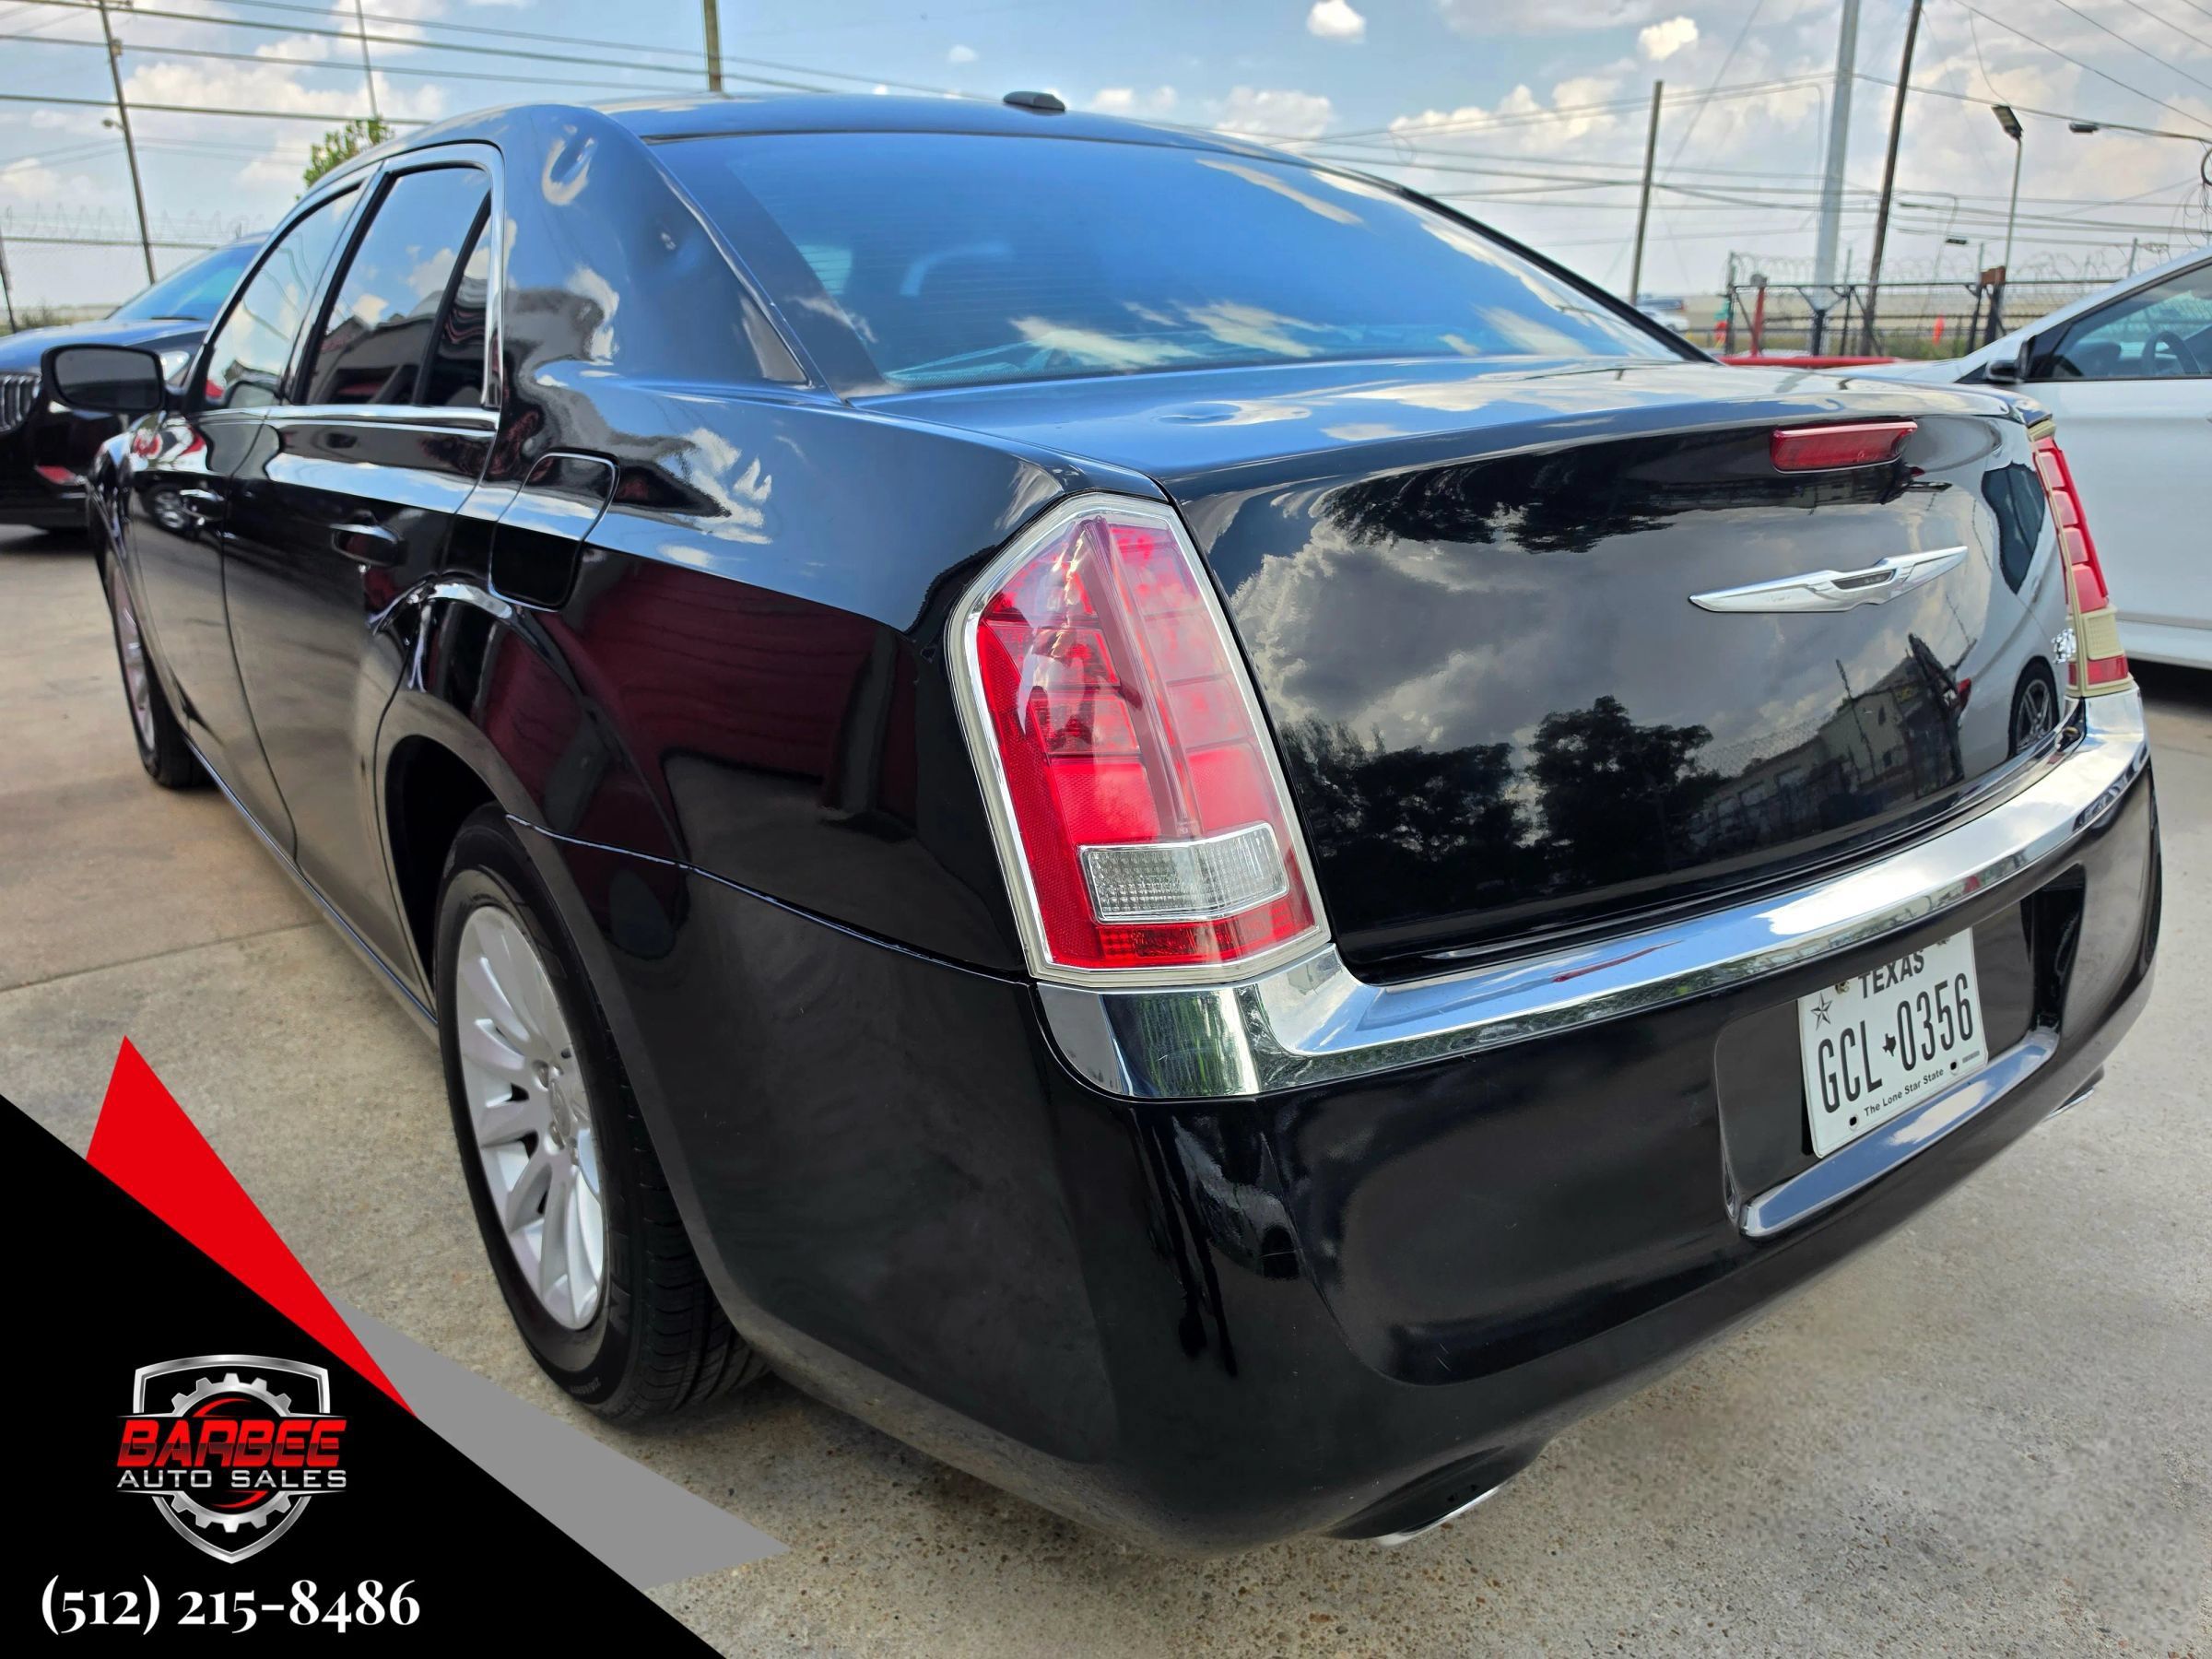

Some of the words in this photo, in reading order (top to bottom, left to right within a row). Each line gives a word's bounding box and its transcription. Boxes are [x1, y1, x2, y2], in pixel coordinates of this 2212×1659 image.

[1858, 949, 1924, 999] TEXAS
[1818, 1020, 1882, 1113] GCL
[1897, 972, 1973, 1071] 0356
[1864, 1101, 1880, 1117] The
[1882, 1091, 1902, 1107] Lone
[1904, 1079, 1921, 1095] Star
[1923, 1069, 1944, 1085] State
